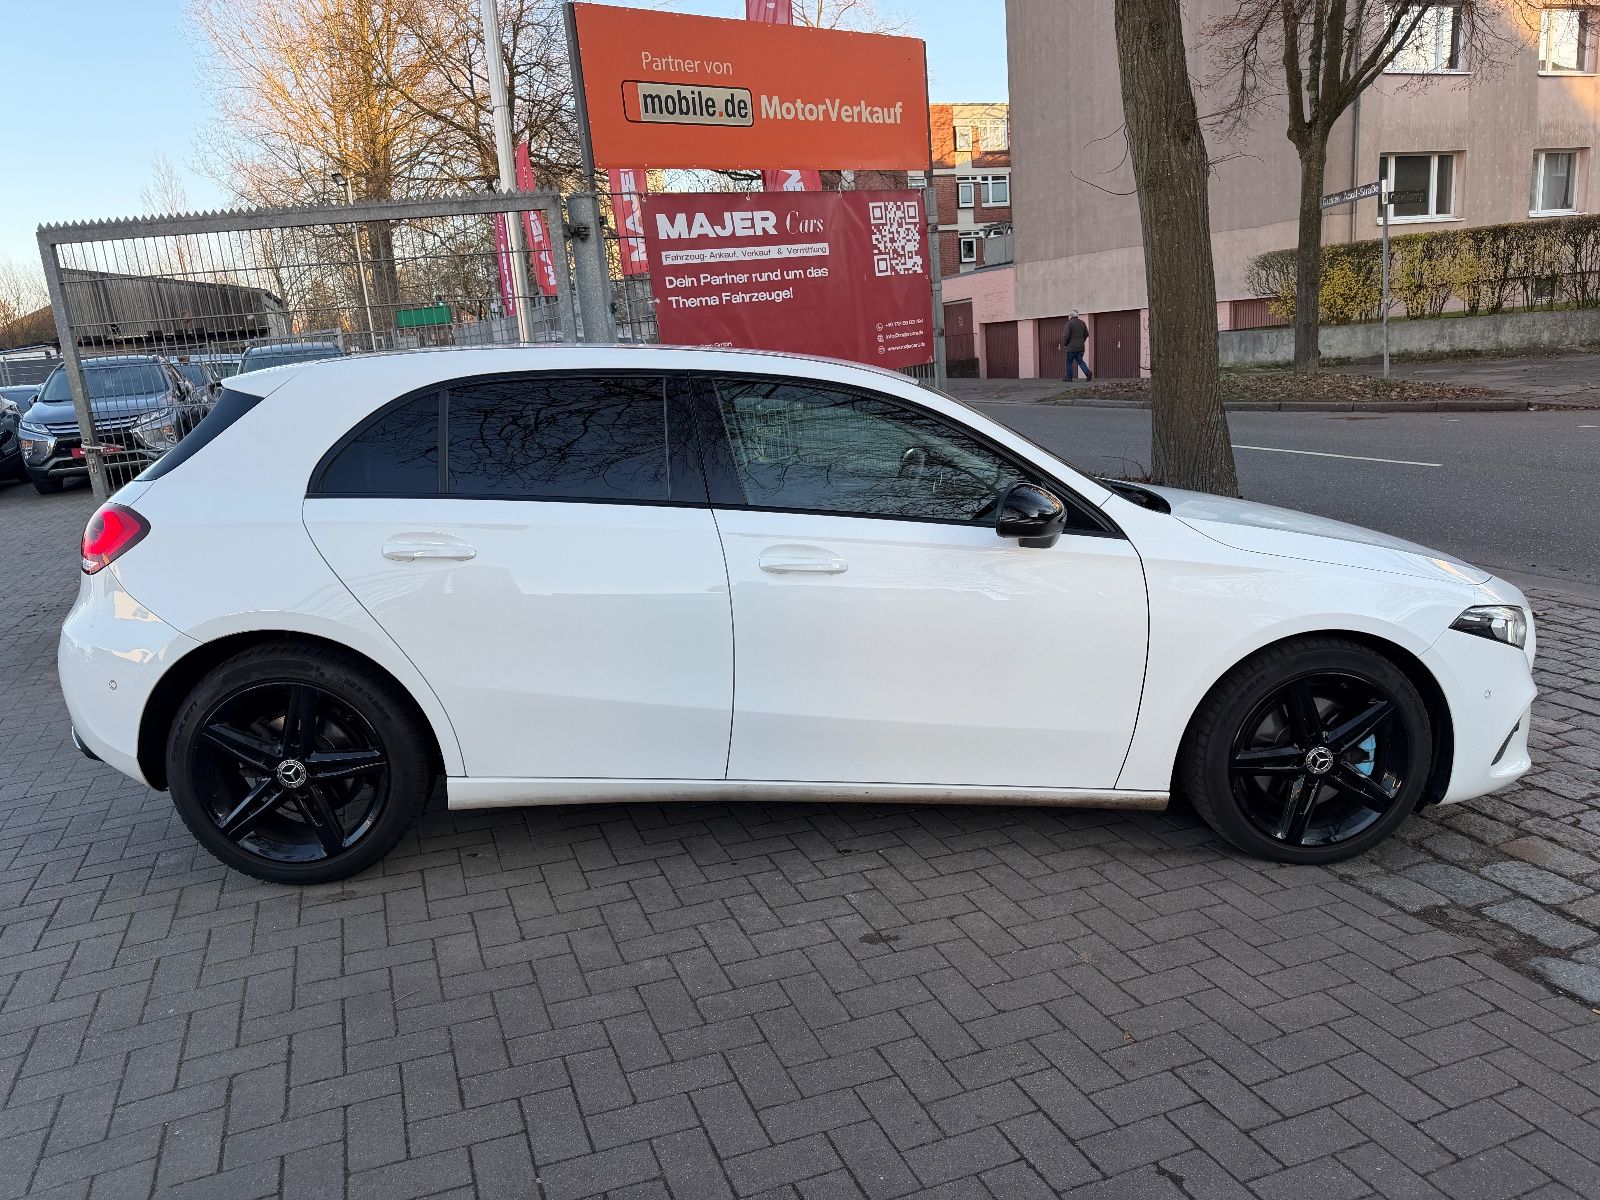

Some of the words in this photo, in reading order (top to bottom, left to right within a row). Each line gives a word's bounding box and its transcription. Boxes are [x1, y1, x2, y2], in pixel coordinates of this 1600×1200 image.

[641, 51, 700, 73] Partner
[704, 60, 733, 75] von
[642, 89, 749, 119] mobile.de
[760, 94, 903, 124] MotorVerkauf
[655, 210, 778, 240] MAJER
[785, 210, 824, 235] Cars
[741, 248, 771, 257] Verkauf
[777, 247, 783, 255] &
[665, 275, 697, 289] Dein
[700, 272, 749, 286] Partner
[751, 268, 781, 282] rund
[784, 269, 804, 280] um
[806, 266, 829, 278] das
[667, 294, 719, 308] Thema
[722, 286, 794, 305] Fahrzeuge!
